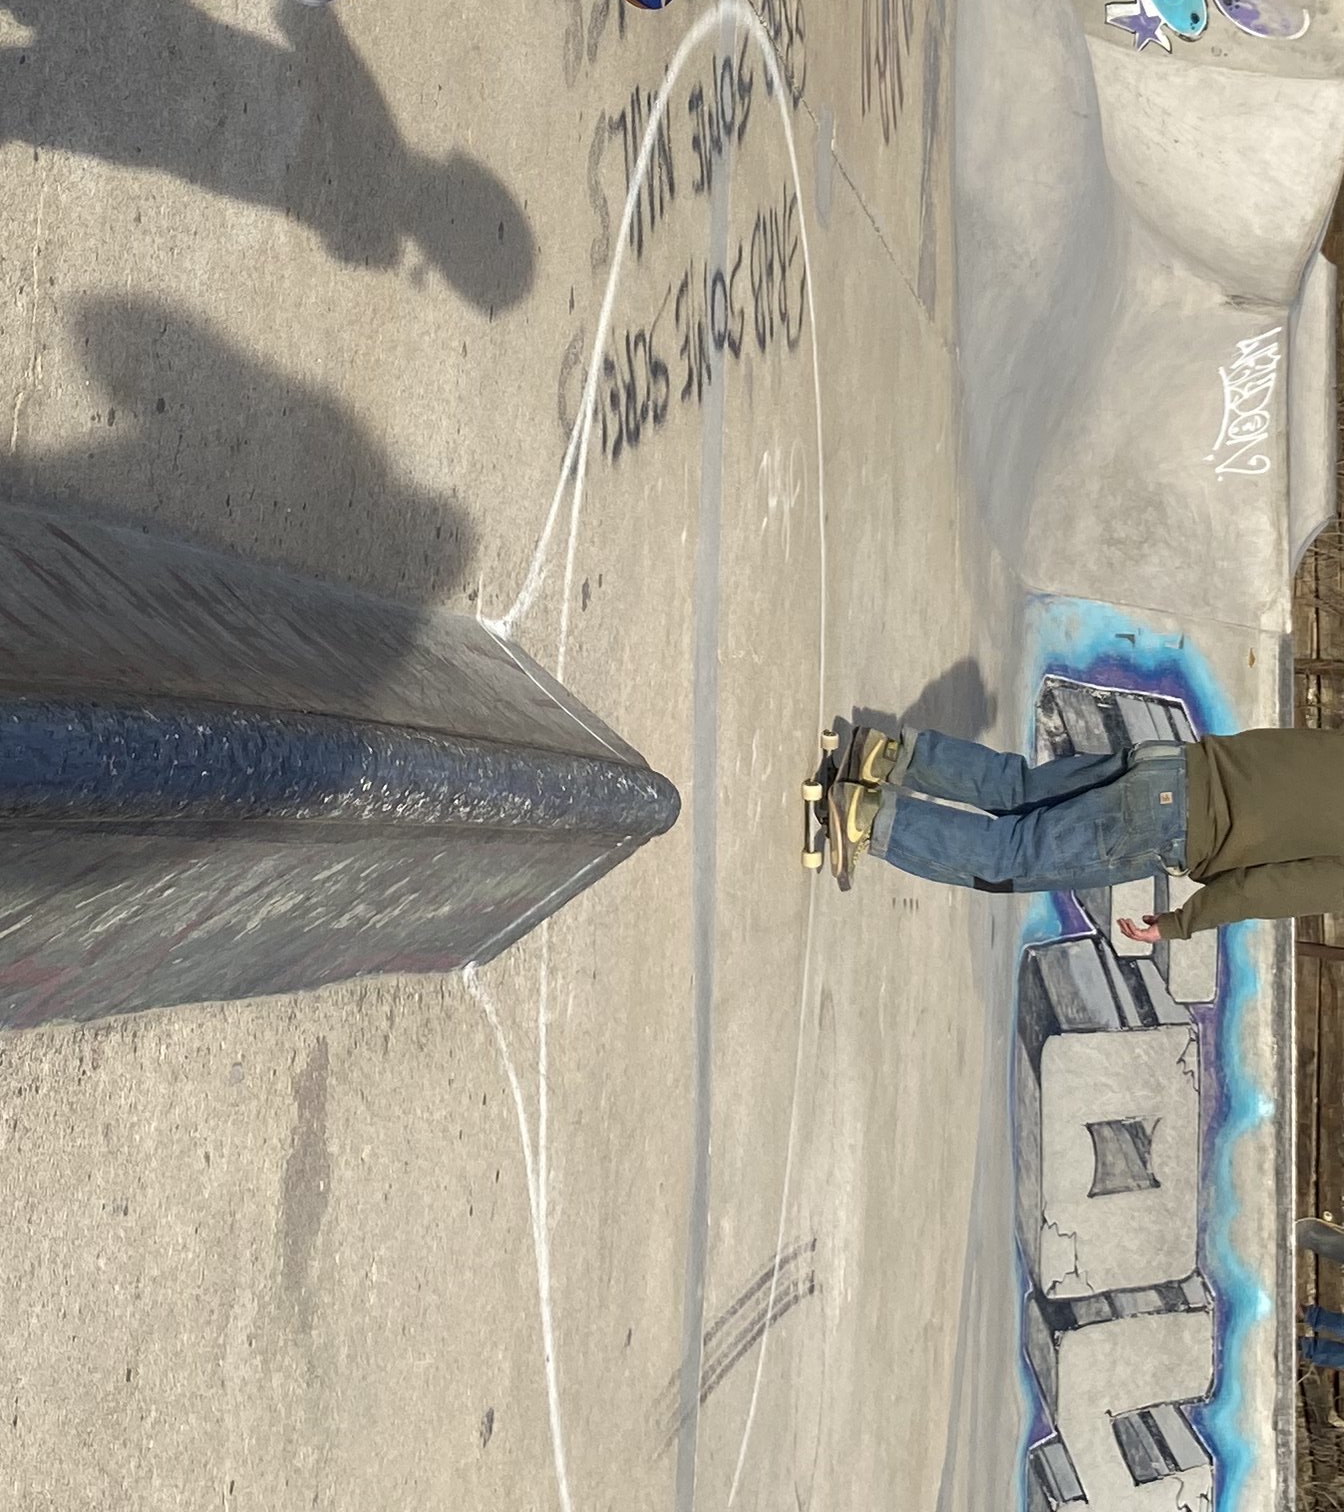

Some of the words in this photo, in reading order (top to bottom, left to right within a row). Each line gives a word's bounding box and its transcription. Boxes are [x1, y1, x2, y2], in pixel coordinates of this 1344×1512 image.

[688, 34, 756, 198] SOME
[674, 243, 746, 405] SOME
[748, 185, 807, 355] GRAB
